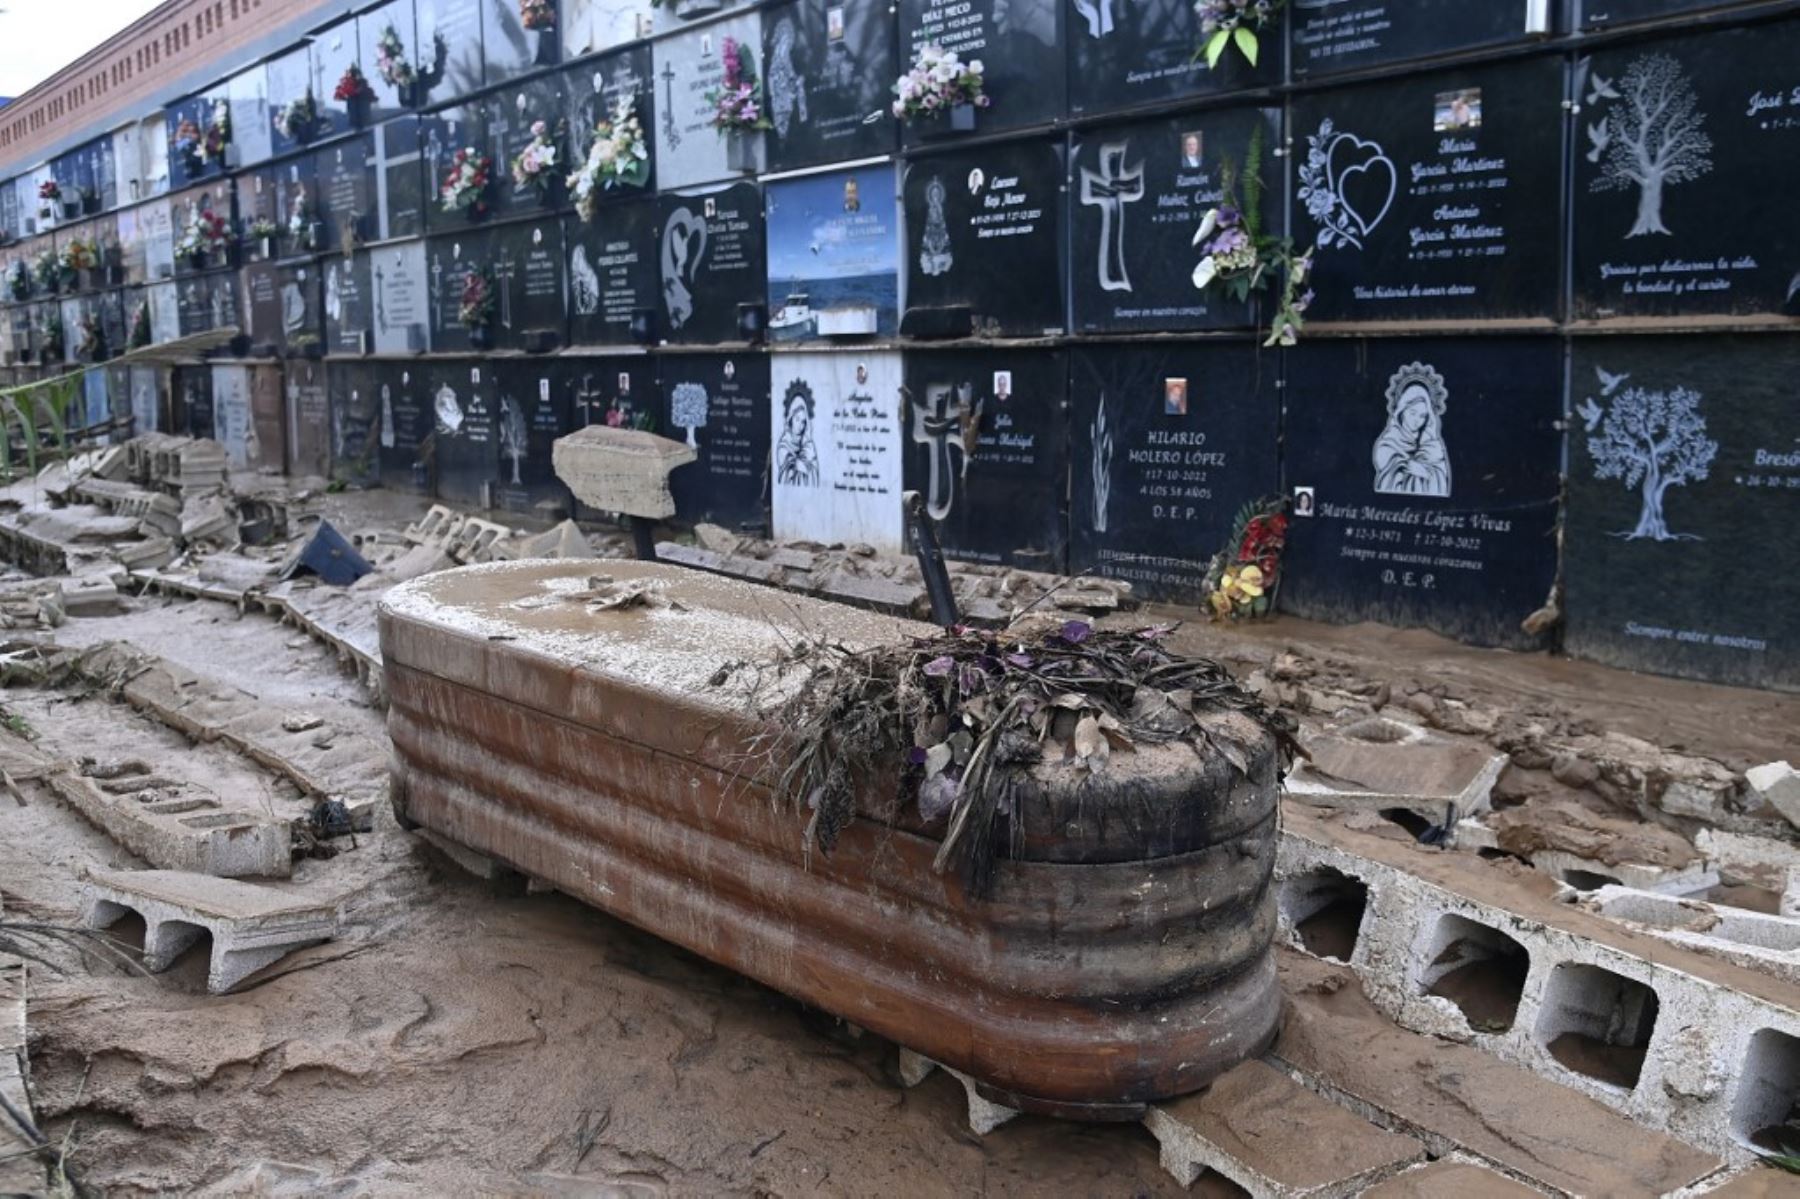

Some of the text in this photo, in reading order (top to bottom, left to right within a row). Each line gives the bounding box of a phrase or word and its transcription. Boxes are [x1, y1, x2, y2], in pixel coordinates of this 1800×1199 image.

[1745, 89, 1784, 117] José
[1410, 157, 1506, 182] García Martínez
[1433, 204, 1480, 220] Antonio
[1409, 223, 1505, 247] García Martínez
[1600, 262, 1637, 280] Gracias
[1717, 256, 1729, 270] la
[1373, 284, 1408, 299] historia
[1685, 278, 1697, 291] el
[1113, 306, 1140, 320] Siempre
[1141, 308, 1151, 318] en
[1147, 430, 1207, 446] HILARIO
[1128, 448, 1227, 467] MOLERO LÓPEZ
[1139, 485, 1148, 496] A
[1149, 486, 1168, 498] LOS
[1184, 486, 1213, 500] AÑOS
[1361, 505, 1421, 525] Mercedes
[1423, 510, 1466, 533] López
[1340, 545, 1376, 561] Siempre
[1378, 550, 1390, 560] en
[1625, 620, 1766, 651] Siempre entre nosotros
